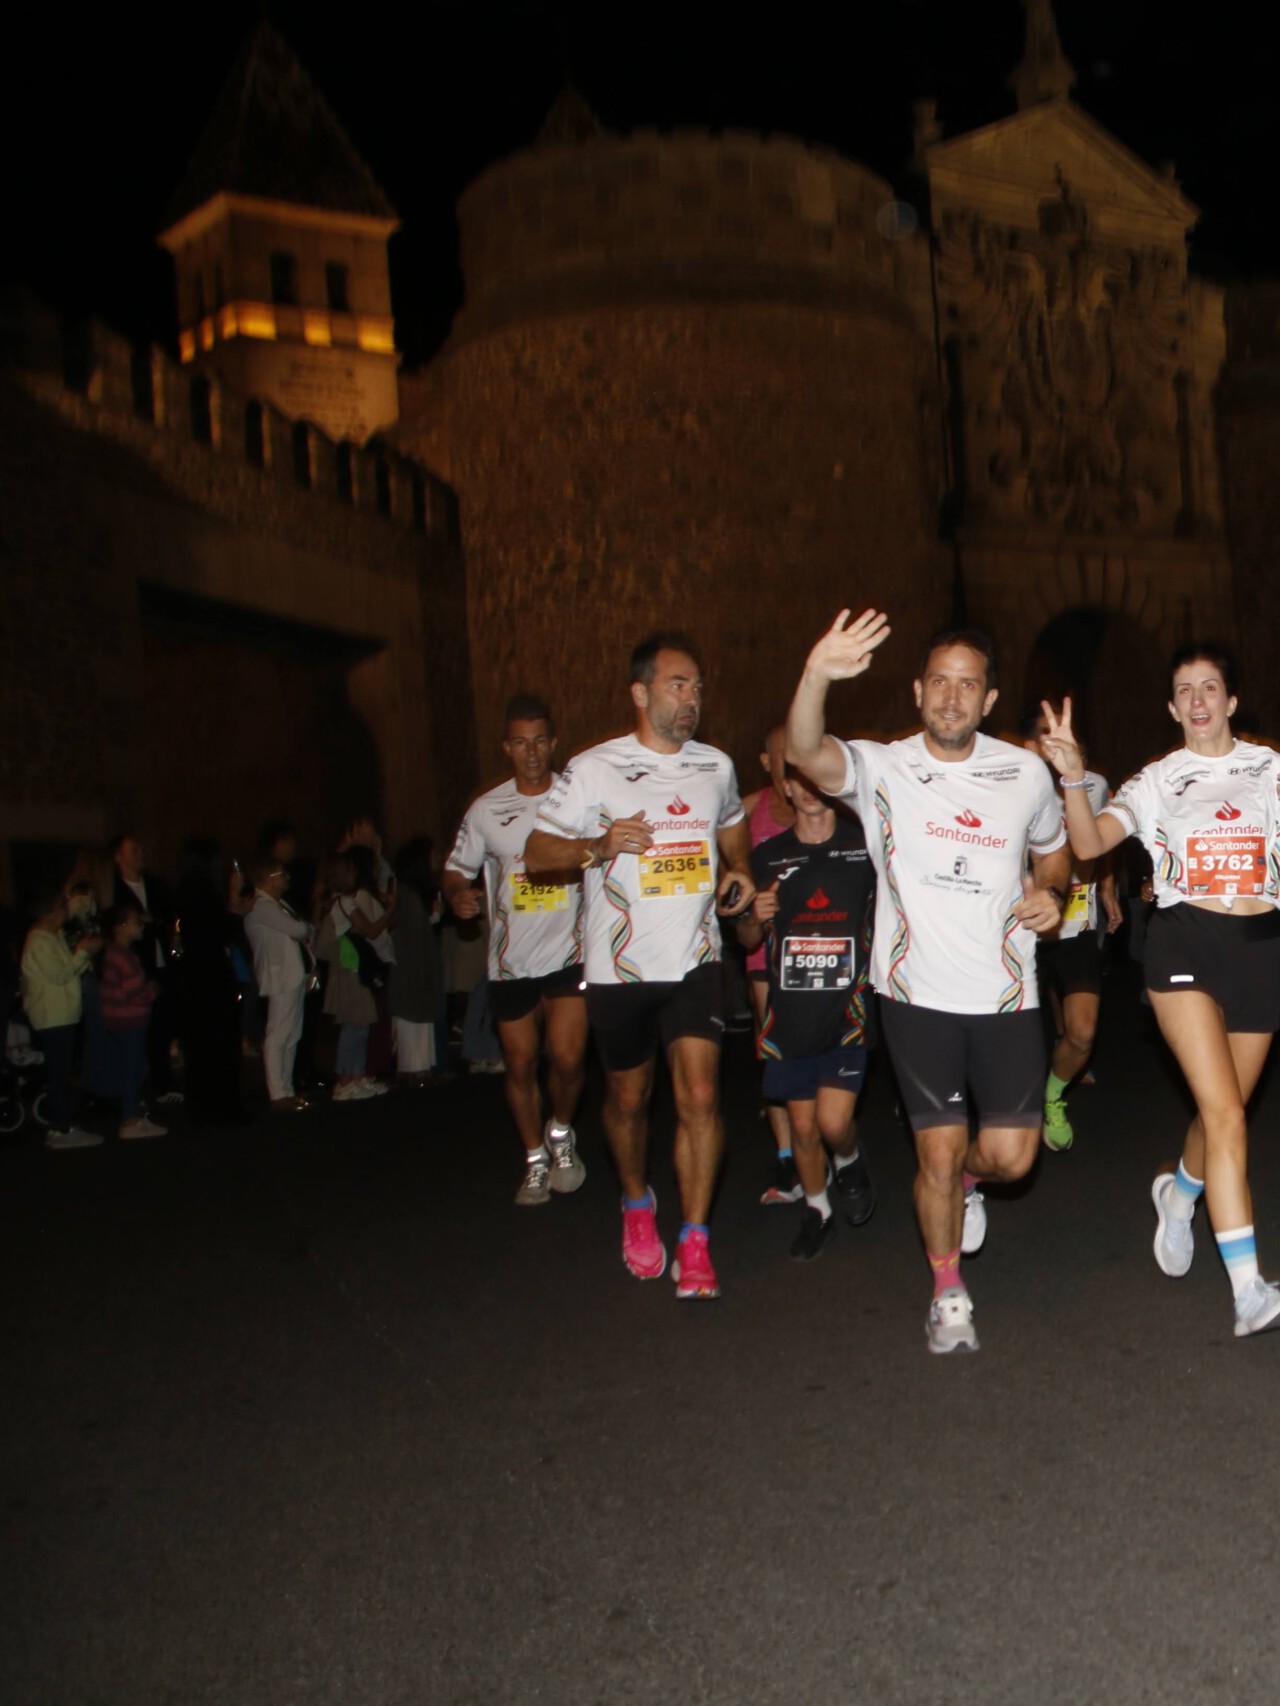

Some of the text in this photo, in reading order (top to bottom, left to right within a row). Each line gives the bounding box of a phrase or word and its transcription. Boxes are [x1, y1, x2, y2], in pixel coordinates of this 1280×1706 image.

[925, 820, 1009, 849] Santander
[656, 844, 704, 857] Santander
[1209, 840, 1260, 851] Santander
[652, 857, 697, 874] 2636
[1202, 854, 1254, 871] 3762
[520, 884, 556, 896] 2192
[801, 943, 846, 952] Santander
[795, 954, 838, 969] 5090
